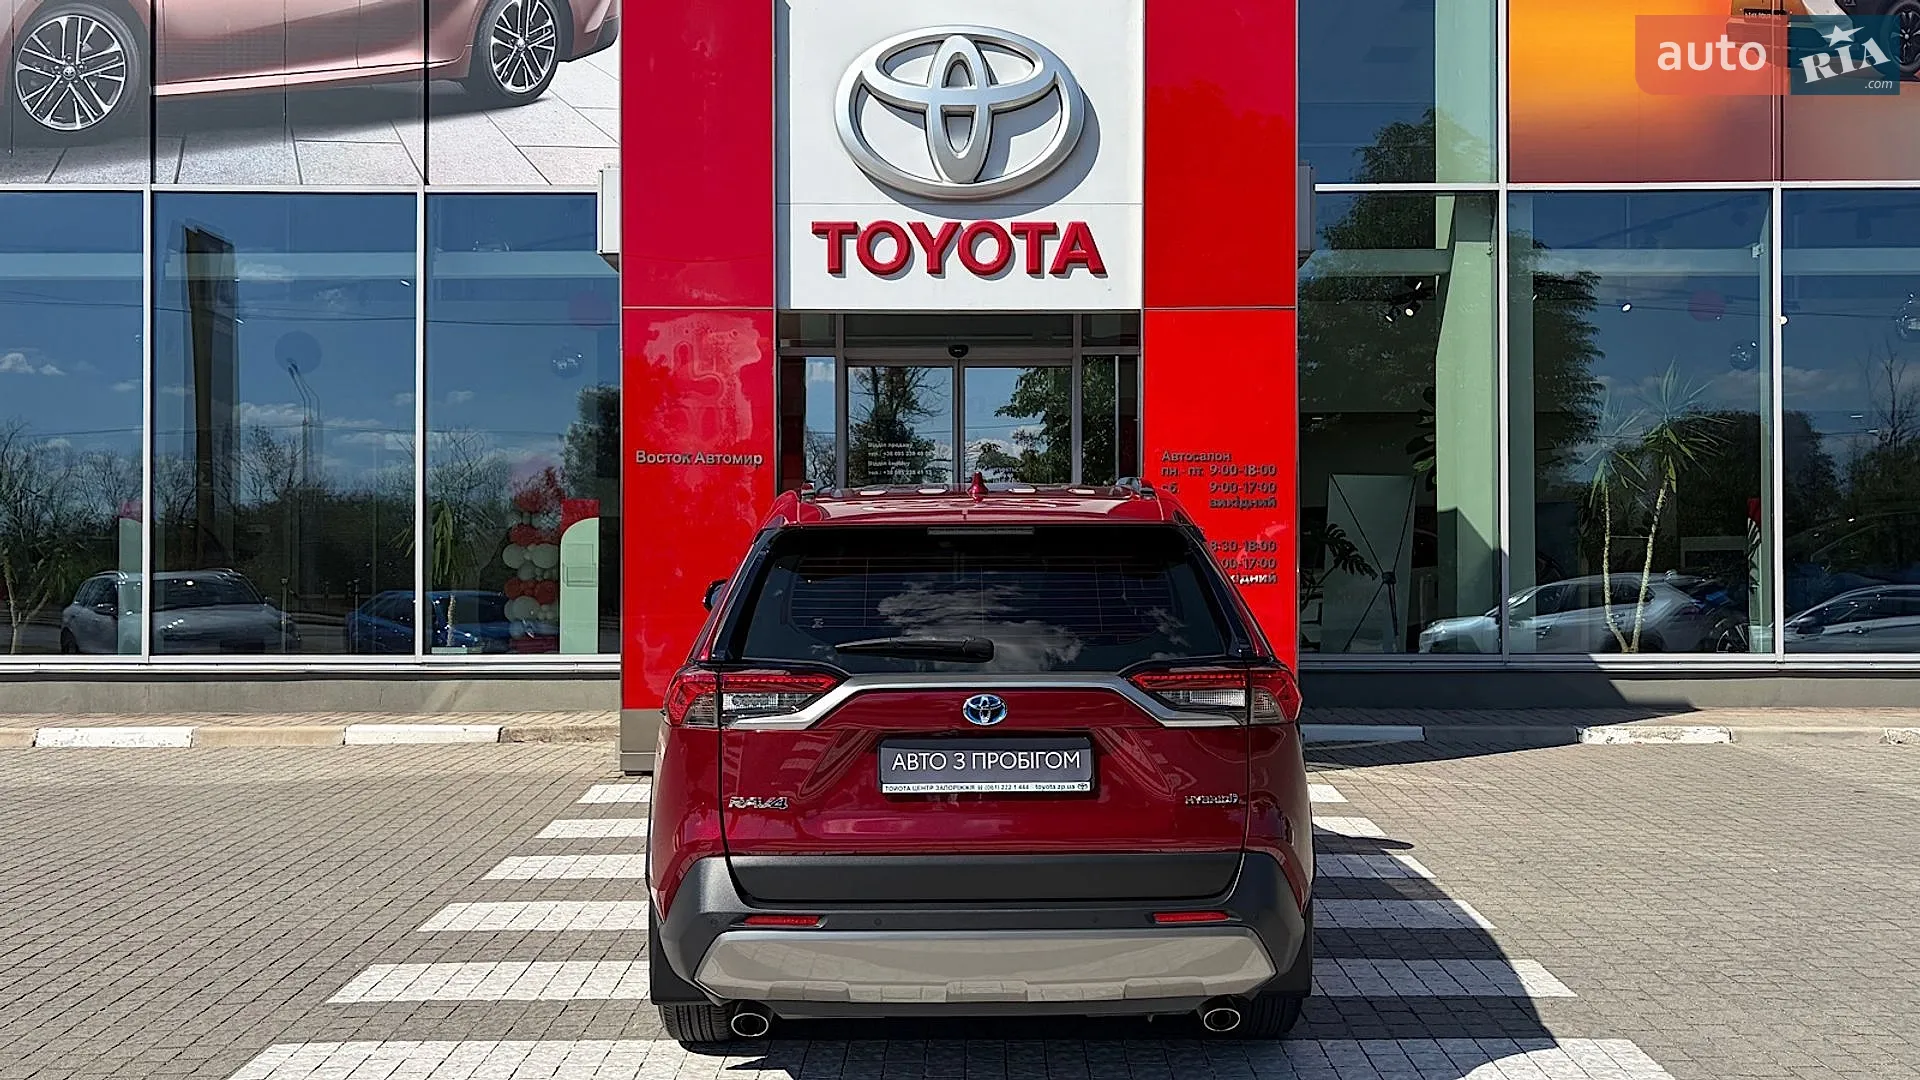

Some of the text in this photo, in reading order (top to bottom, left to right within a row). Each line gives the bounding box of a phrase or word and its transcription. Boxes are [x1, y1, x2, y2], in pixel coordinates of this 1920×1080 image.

[812, 220, 1108, 277] TOYOTA
[636, 450, 763, 468] Восток Автомир
[1162, 451, 1232, 462] Автосалон
[1161, 466, 1179, 476] пн
[1188, 466, 1204, 476] пт
[1209, 464, 1277, 476] 9:00-18:00
[1209, 481, 1277, 493] 9:00-17:00
[1209, 496, 1277, 509] вихідний
[1221, 559, 1277, 569] 00-17:00
[1230, 573, 1277, 585] хідний
[891, 751, 1081, 771] АВТО З ПРОБІГОМ
[728, 796, 789, 810] RAV4
